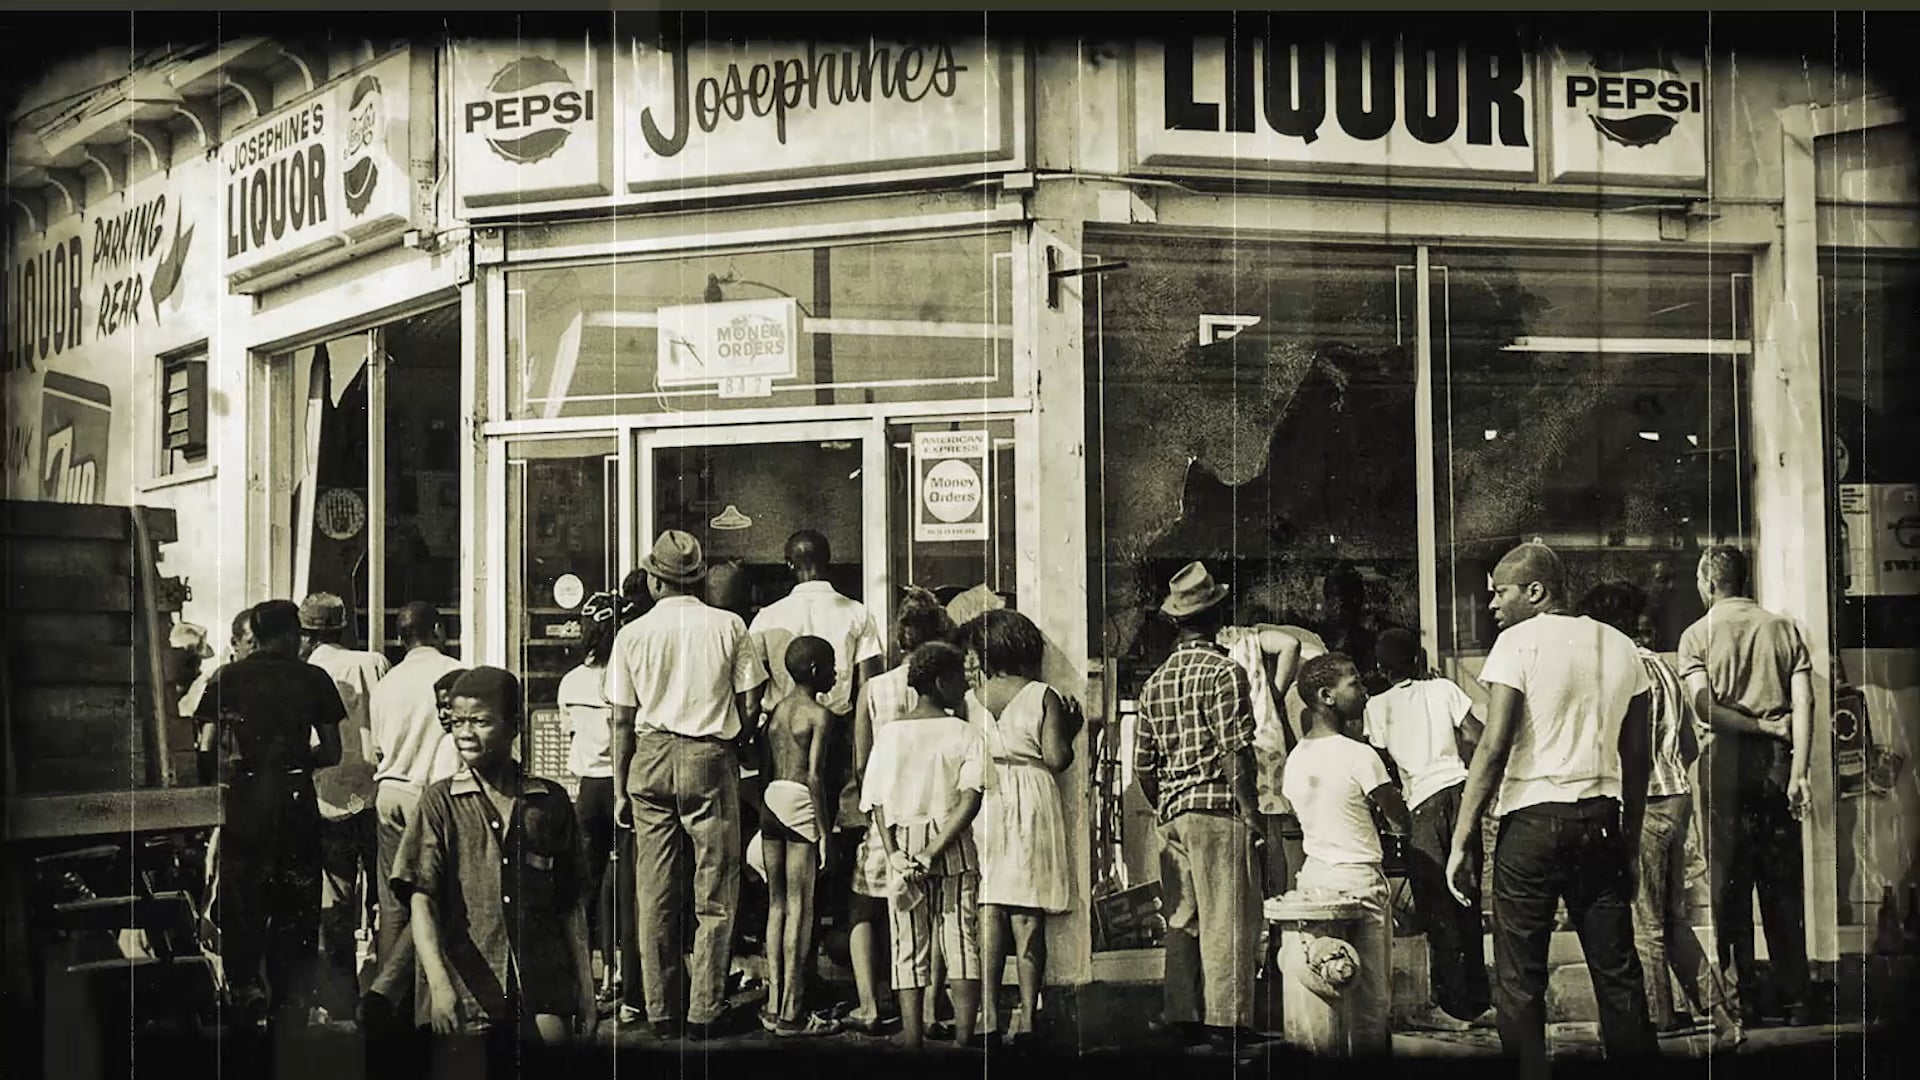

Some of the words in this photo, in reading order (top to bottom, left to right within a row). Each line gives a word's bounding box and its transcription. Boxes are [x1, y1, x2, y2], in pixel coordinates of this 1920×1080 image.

[465, 90, 595, 133] PEPSI
[641, 40, 968, 157] Josephines
[1164, 38, 1530, 146] LIQUOR
[1566, 75, 1701, 113] PEPSI
[229, 102, 324, 175] JOSEPHINE'S
[227, 143, 327, 258] LIQUOR
[91, 194, 166, 280] PARKING
[96, 273, 143, 342] REAR
[717, 324, 783, 341] MONEY
[718, 340, 785, 358] ORDERS
[922, 435, 984, 444] AMERICAN
[924, 444, 979, 453] EXPRESS
[930, 492, 975, 502] Orders
[931, 478, 975, 488] Money
